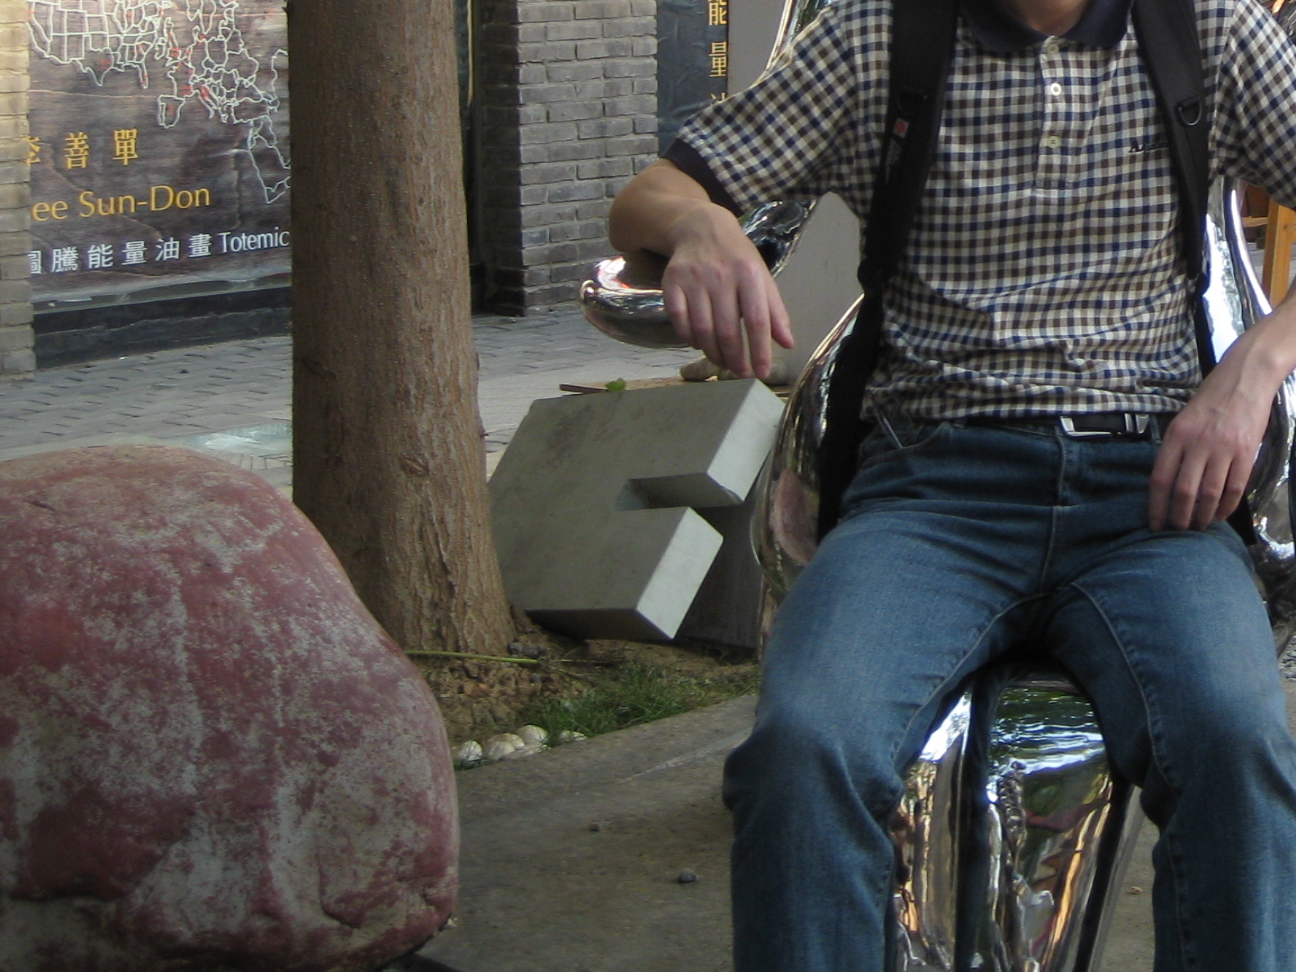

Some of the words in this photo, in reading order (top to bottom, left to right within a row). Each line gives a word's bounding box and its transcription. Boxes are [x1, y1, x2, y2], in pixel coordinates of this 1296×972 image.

[31, 198, 69, 222] ee
[79, 184, 211, 219] Sun-Don
[219, 226, 290, 254] Totemic
